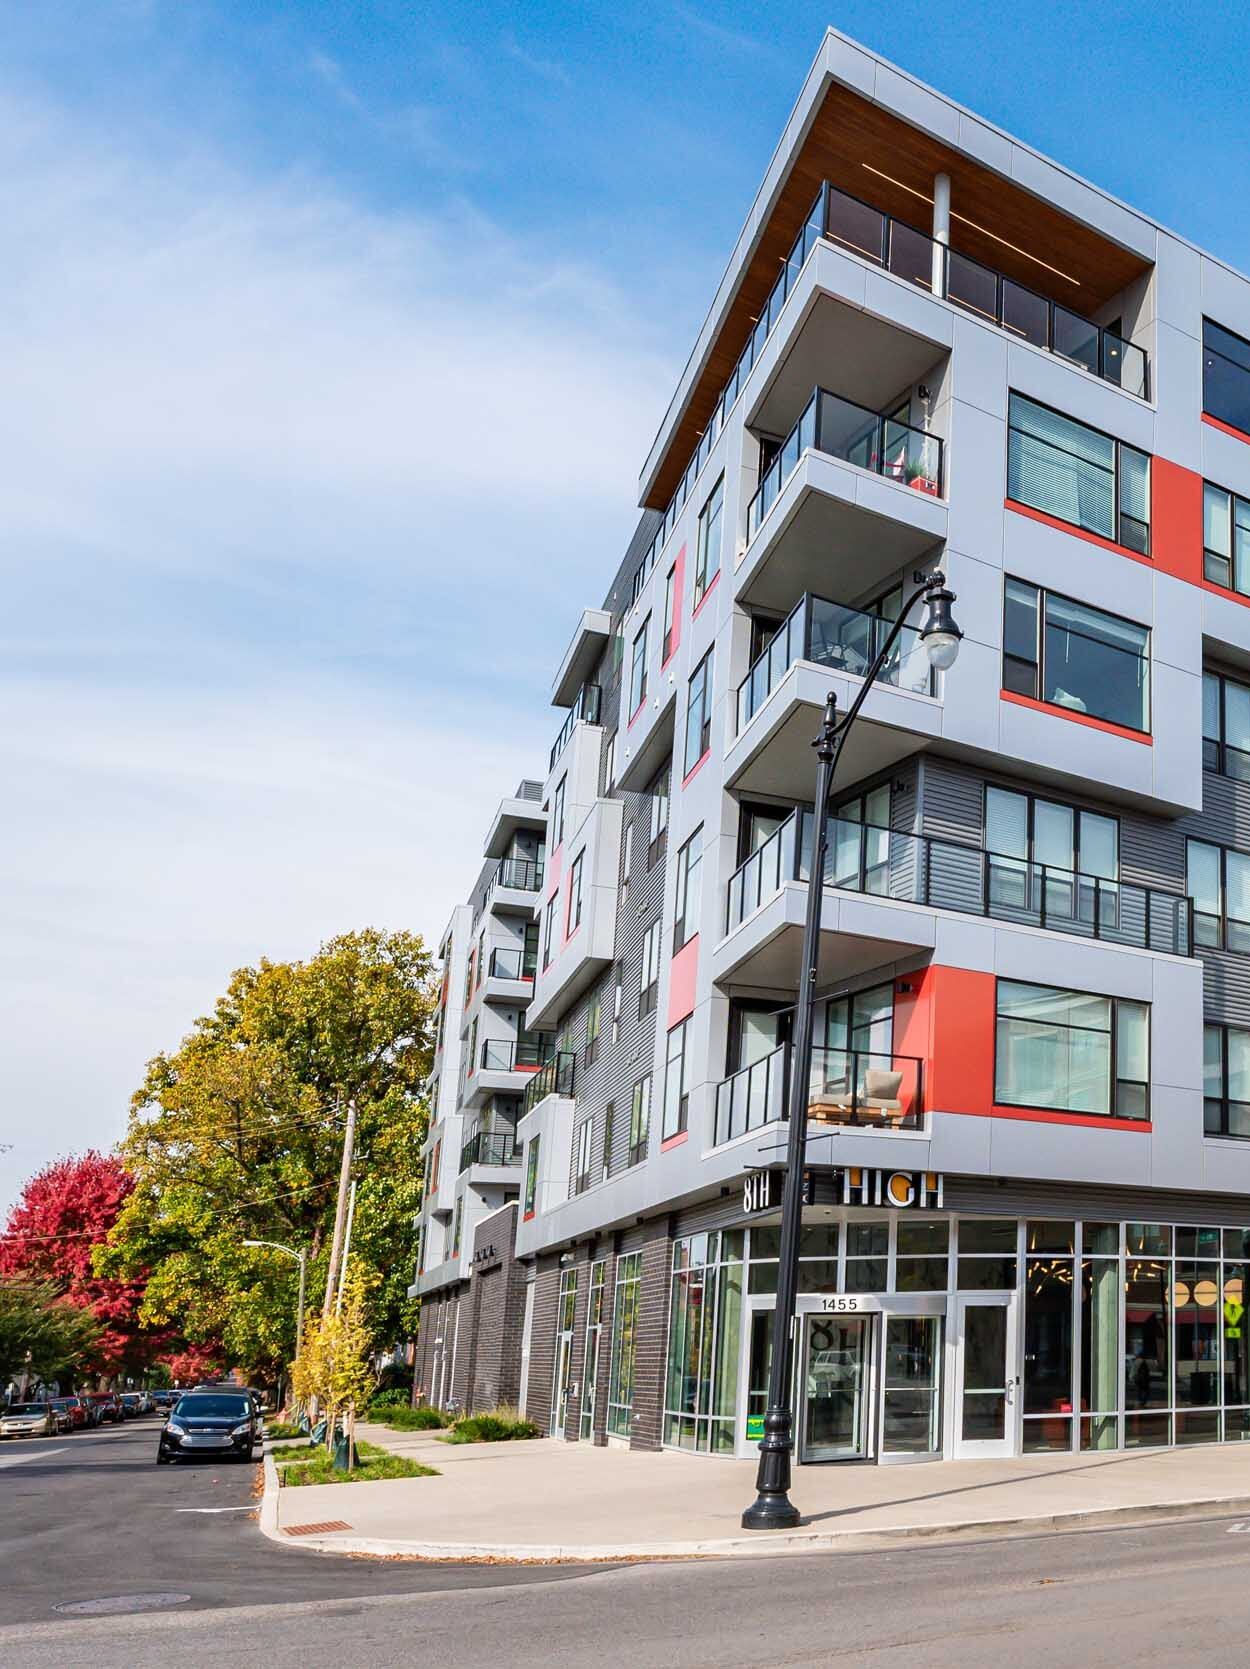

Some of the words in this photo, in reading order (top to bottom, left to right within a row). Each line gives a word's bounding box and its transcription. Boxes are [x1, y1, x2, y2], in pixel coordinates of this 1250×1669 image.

[743, 1170, 770, 1213] 8TH
[843, 1167, 944, 1208] HIGH
[822, 1298, 857, 1311] 1455
